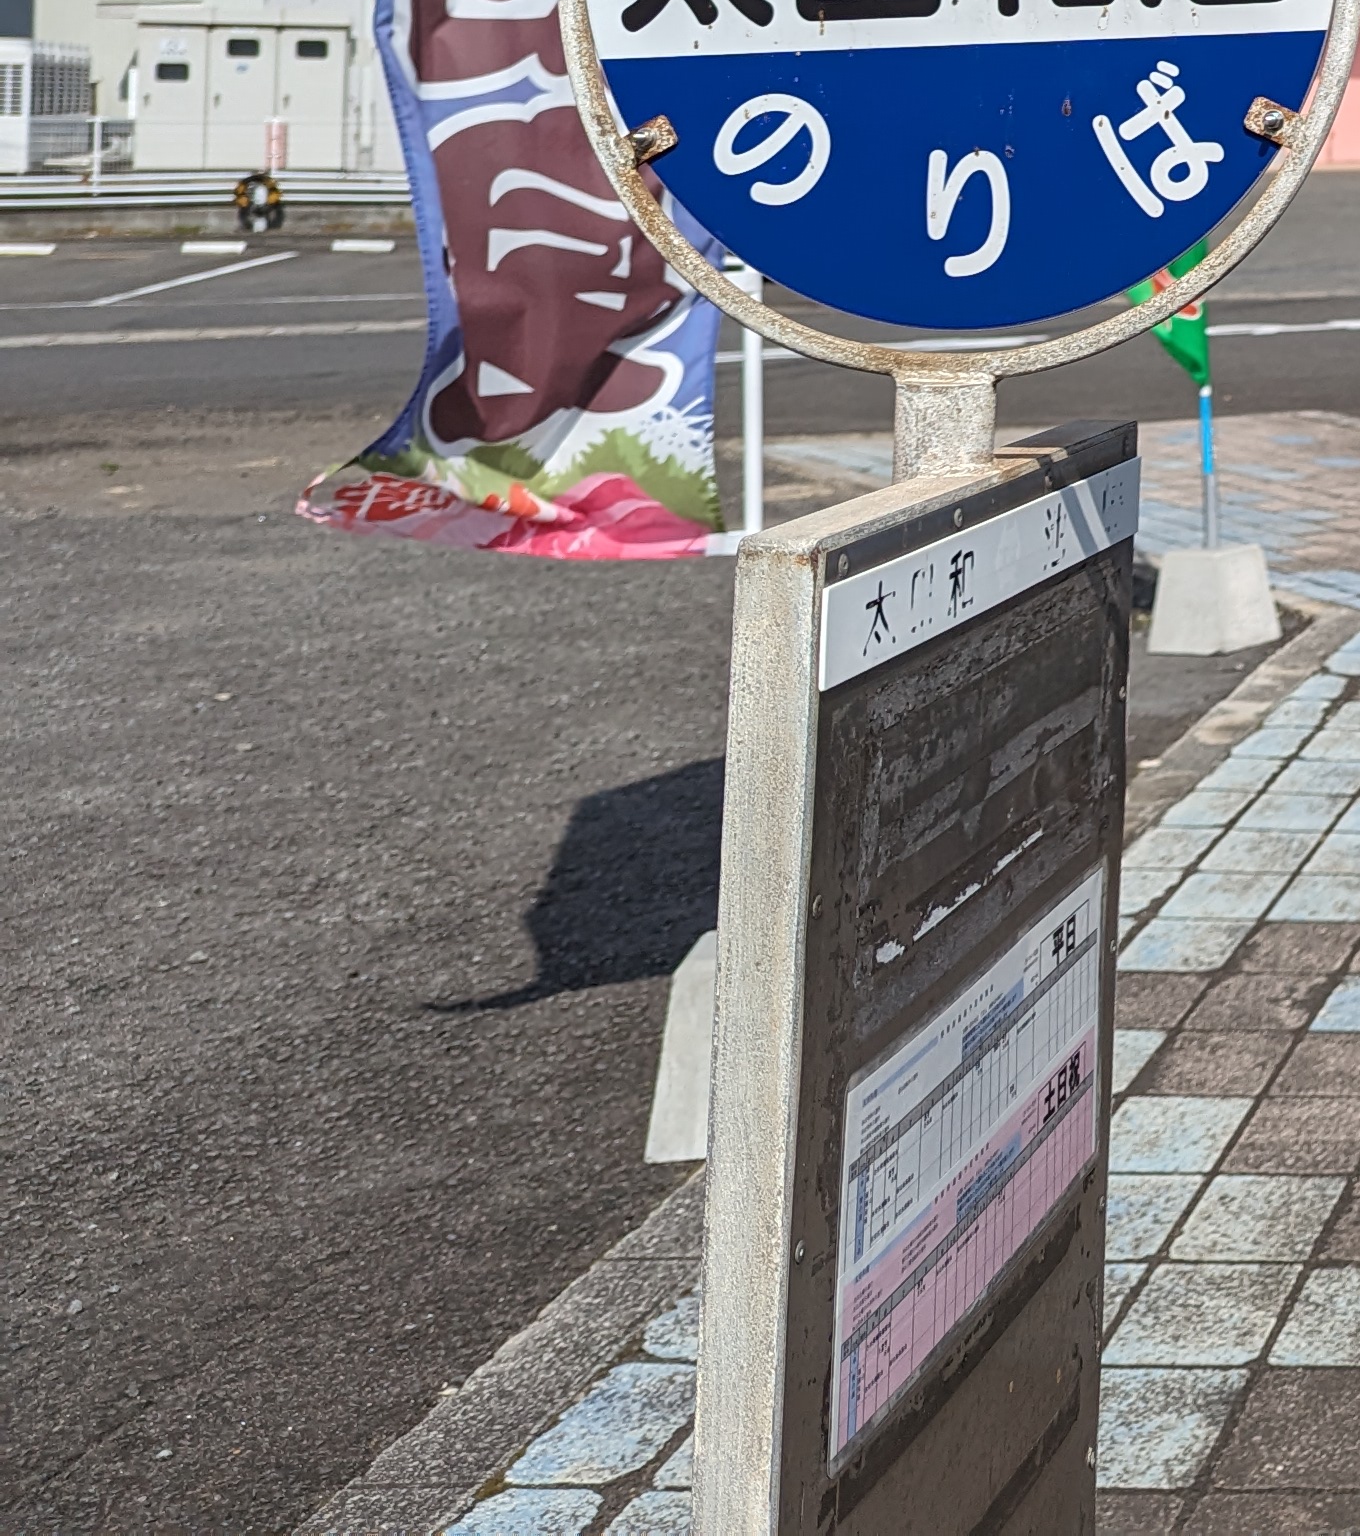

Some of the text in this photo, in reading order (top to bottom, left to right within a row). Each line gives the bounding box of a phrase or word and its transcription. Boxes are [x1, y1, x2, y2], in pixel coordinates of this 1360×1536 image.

[712, 60, 1225, 279] のりば
[1051, 913, 1077, 965] 平日
[1042, 1050, 1081, 1124] 土日祝
